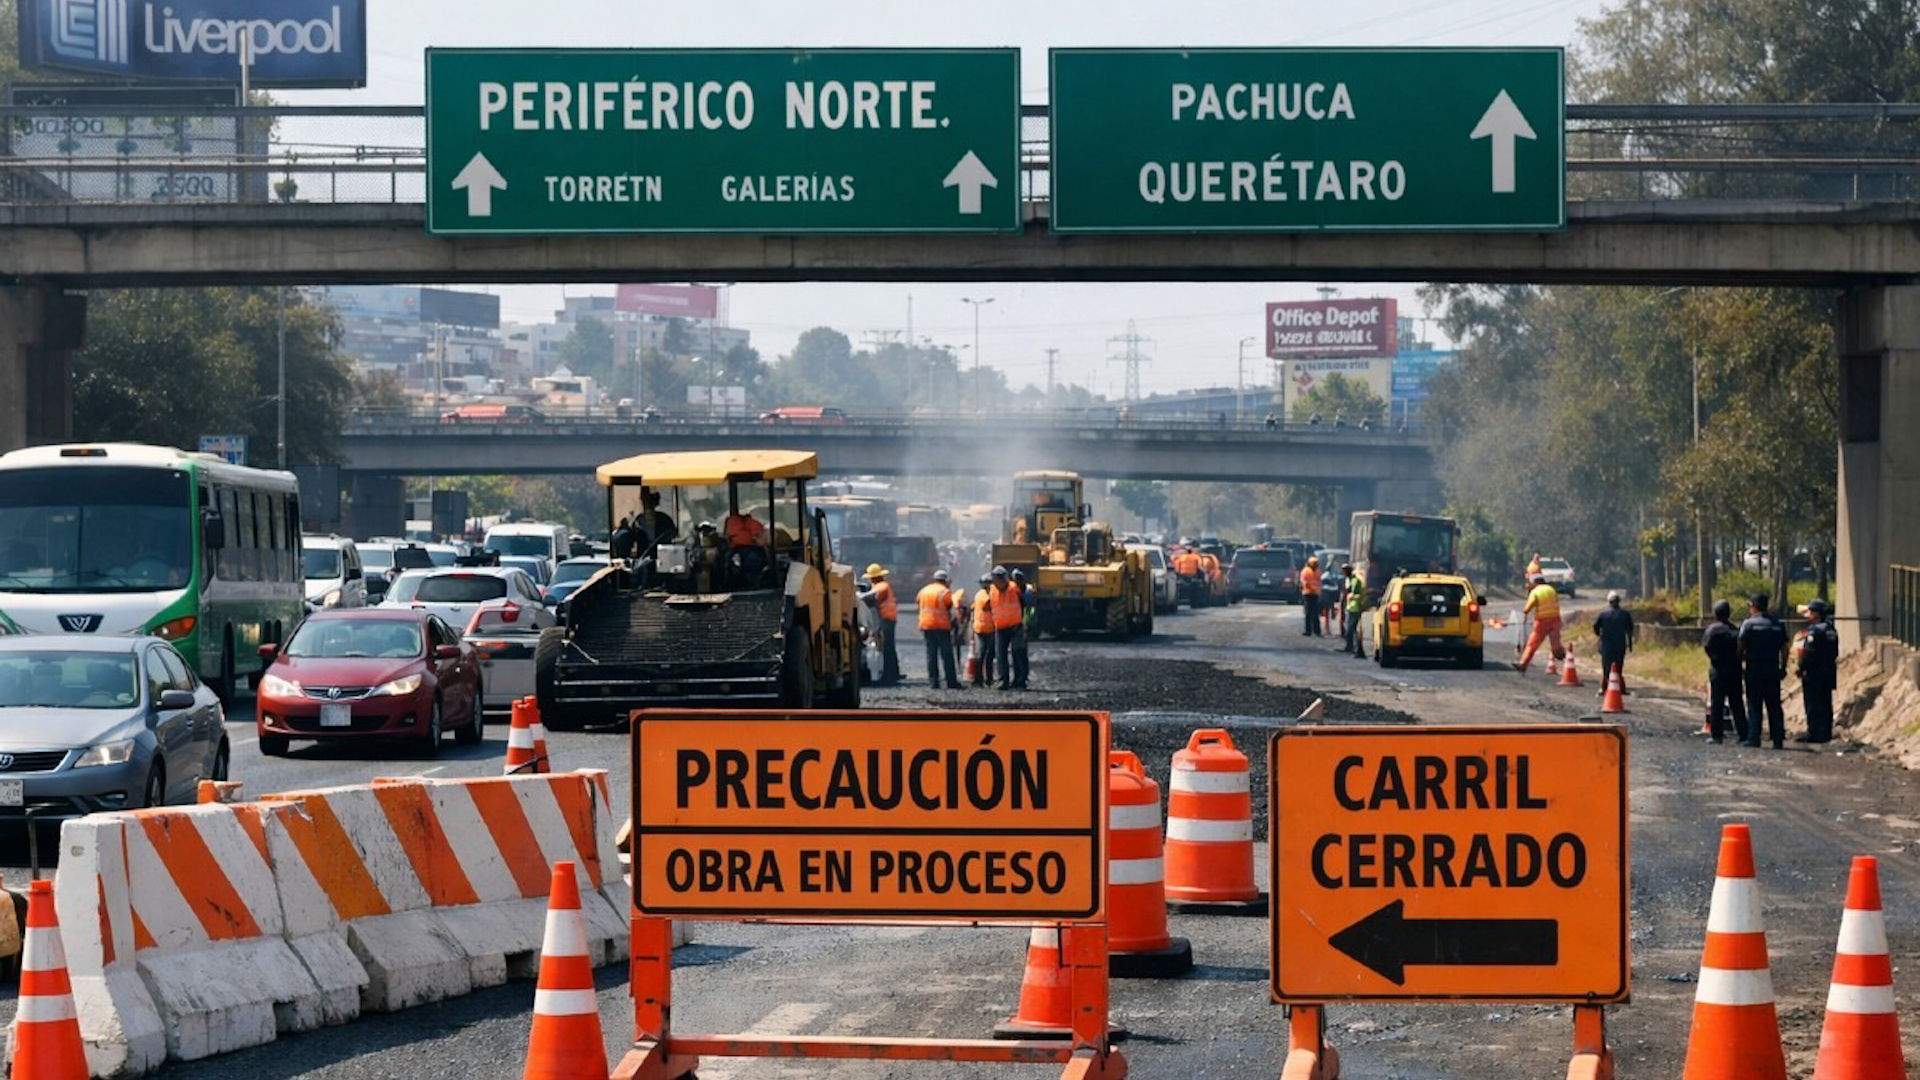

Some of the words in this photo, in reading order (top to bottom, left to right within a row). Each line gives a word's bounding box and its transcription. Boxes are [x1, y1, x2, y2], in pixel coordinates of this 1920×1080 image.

[145, 3, 341, 66] Liverpool
[479, 75, 754, 130] PERIFÉRICO
[786, 80, 949, 129] NORTE.
[1172, 82, 1355, 120] PACHUCA
[722, 172, 855, 202] GALERÍAS
[1139, 153, 1405, 203] QUERÉTARO
[1273, 308, 1322, 327] Office
[1326, 307, 1379, 328] Depot
[677, 734, 1048, 810] PRECAUCIÓN
[1334, 756, 1547, 811] CARRIL
[666, 849, 783, 893] OBRA
[800, 850, 852, 893] EN
[871, 851, 1066, 894] PROCESO
[1312, 833, 1587, 889] CERRADO
